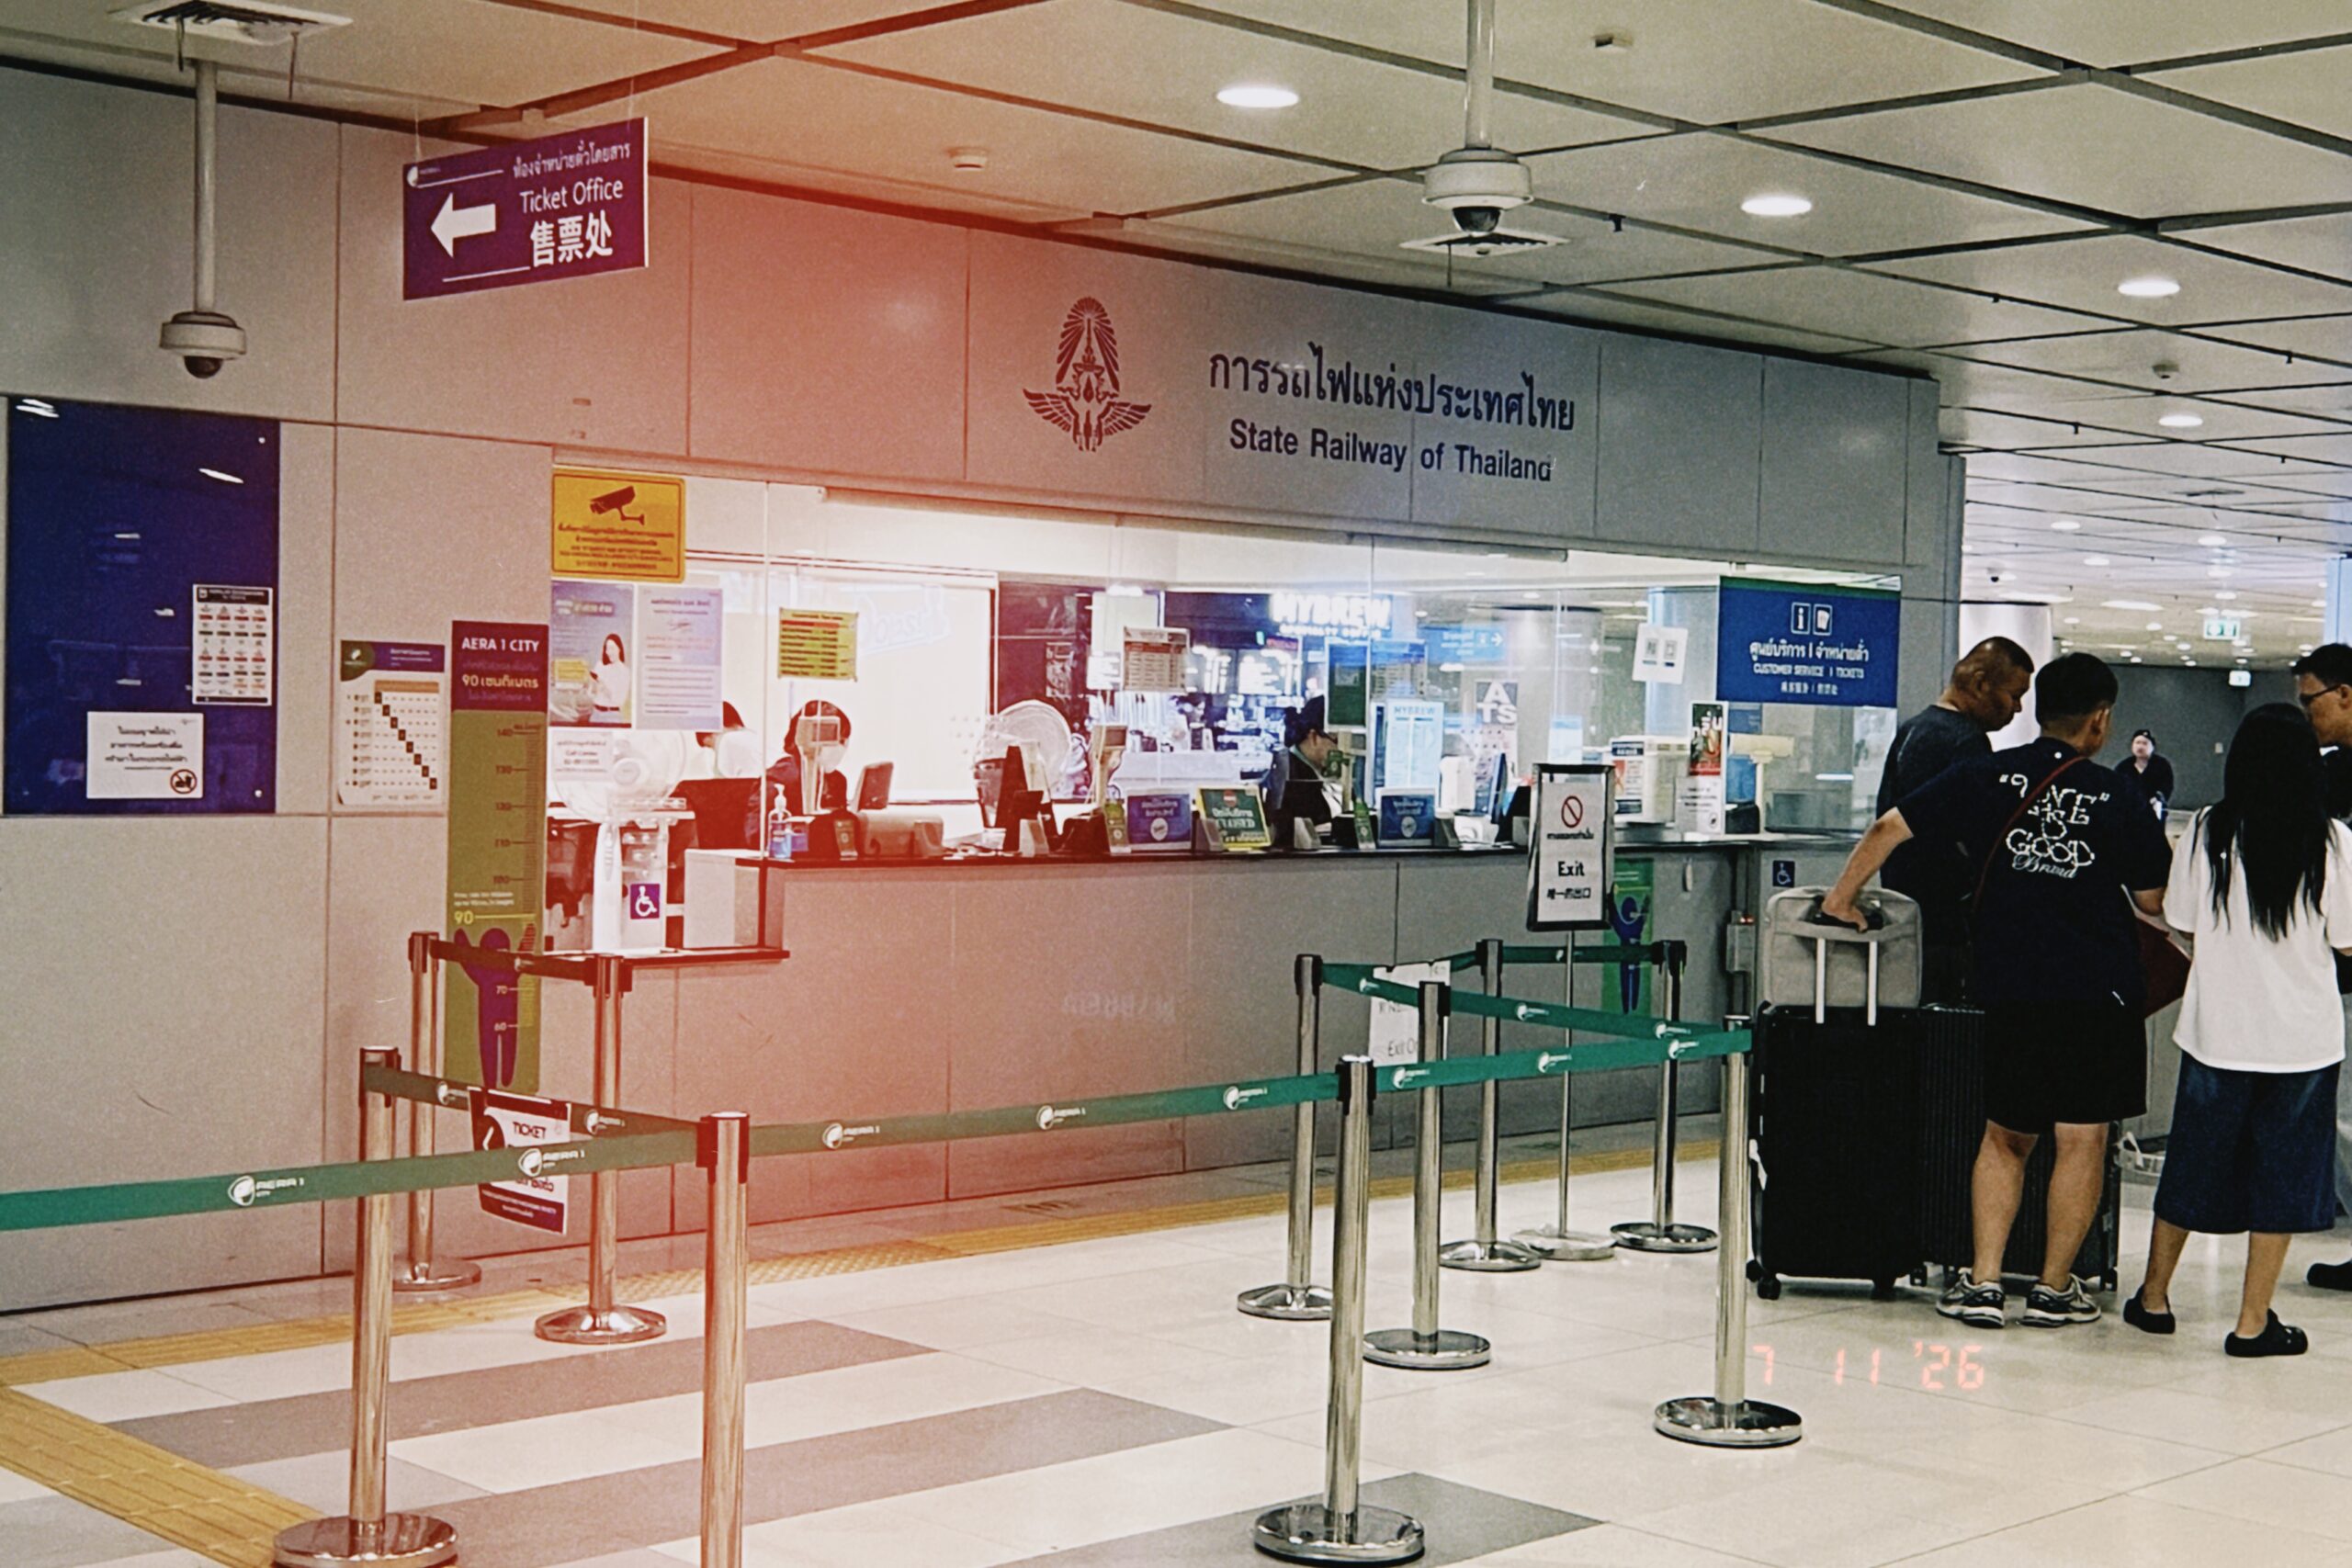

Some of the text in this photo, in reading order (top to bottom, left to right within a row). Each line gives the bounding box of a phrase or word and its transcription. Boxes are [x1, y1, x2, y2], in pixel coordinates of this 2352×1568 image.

[519, 176, 624, 214] Ticket Office
[530, 209, 613, 267] 售票处
[1209, 341, 1575, 431] การรถไฟแห่งประเทศไทย
[1229, 418, 1553, 482] State Railway of Thailand
[461, 637, 497, 650] AERA
[509, 639, 539, 652] CITY
[462, 673, 479, 686] 90
[1557, 860, 1585, 876] Exit
[454, 910, 474, 925] 90
[512, 1121, 547, 1139] TICKET
